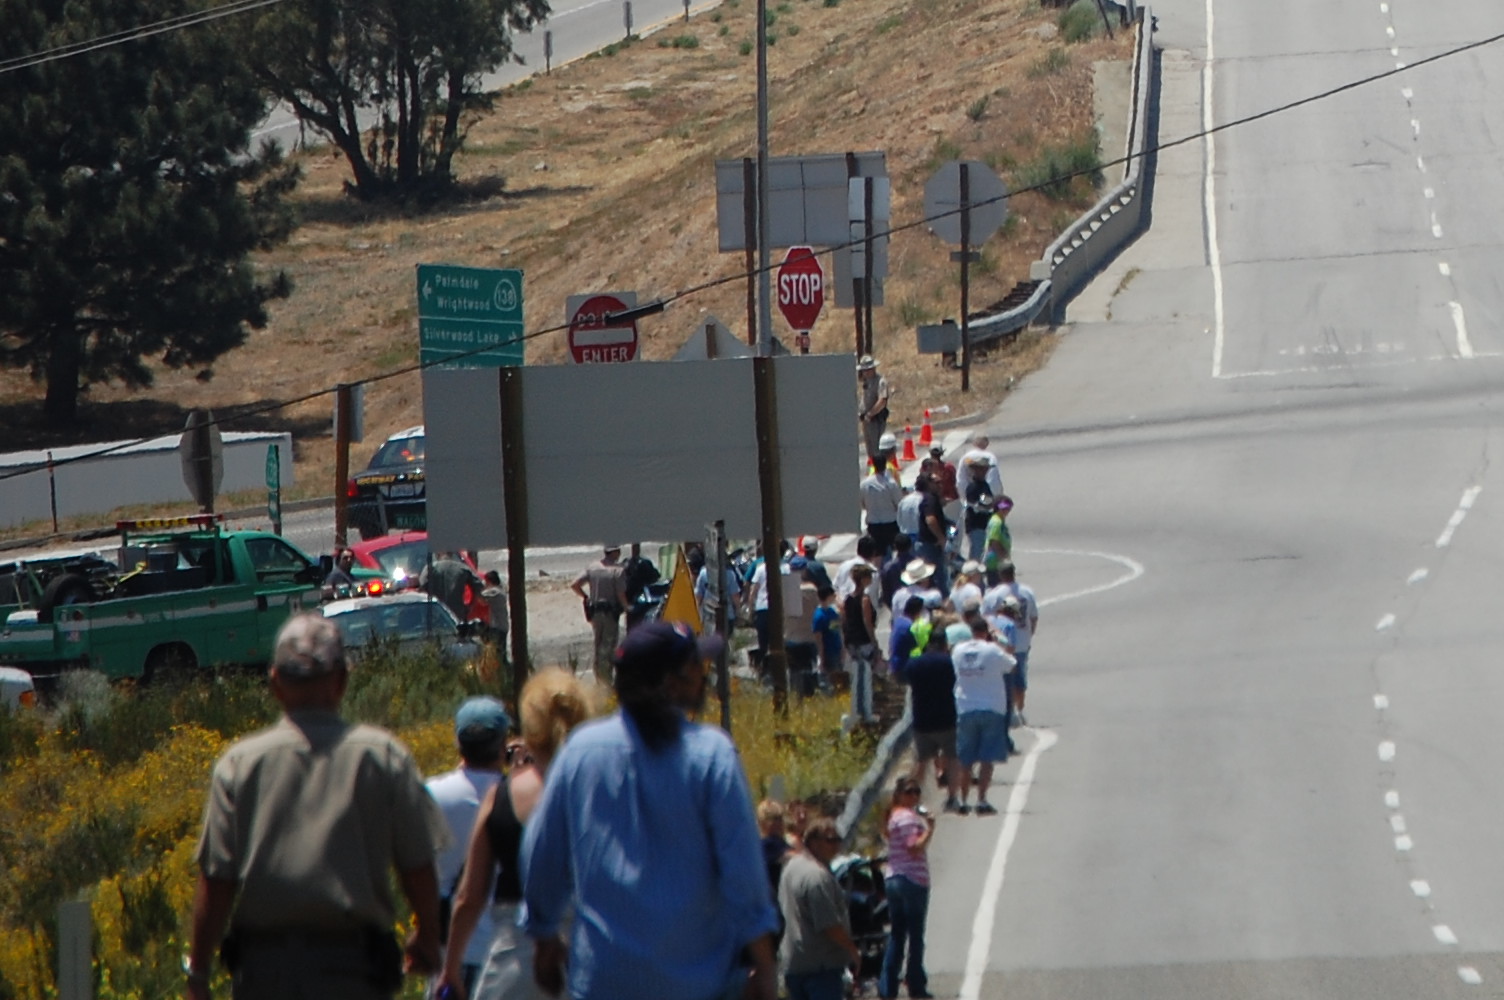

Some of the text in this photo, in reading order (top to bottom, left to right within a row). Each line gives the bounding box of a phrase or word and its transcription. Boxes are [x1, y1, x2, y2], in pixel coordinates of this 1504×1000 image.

[435, 274, 480, 289] Palmdale
[780, 273, 821, 305] STOP
[437, 297, 491, 312] Wrightwood
[496, 287, 515, 306] 138
[423, 327, 500, 344] Silverwood Lake
[581, 347, 628, 363] ENTER
